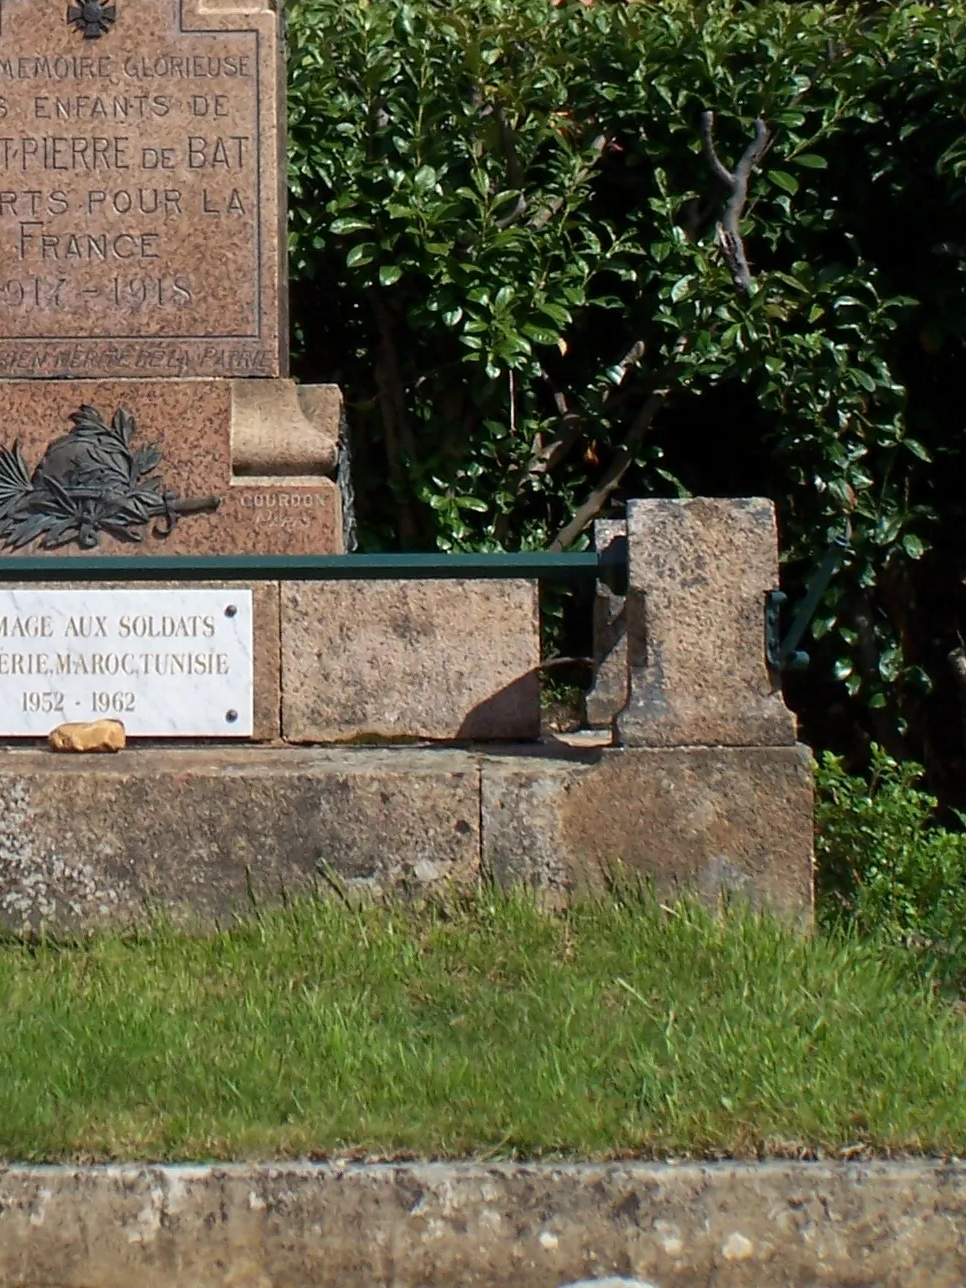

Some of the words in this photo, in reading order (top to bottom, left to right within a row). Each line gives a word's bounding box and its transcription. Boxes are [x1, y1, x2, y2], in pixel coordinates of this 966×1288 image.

[123, 54, 252, 80] GLORIEUSE
[34, 94, 170, 119] ENFANTS
[192, 94, 230, 118] DE
[140, 146, 176, 170] DE
[187, 135, 250, 169] BAT
[87, 187, 183, 216] POUR
[202, 187, 247, 216] LA
[112, 274, 193, 309] 1918
[63, 615, 109, 638] AUX
[118, 614, 216, 638] SOLDATS
[22, 691, 65, 712] 1952
[91, 691, 136, 712] 1962
